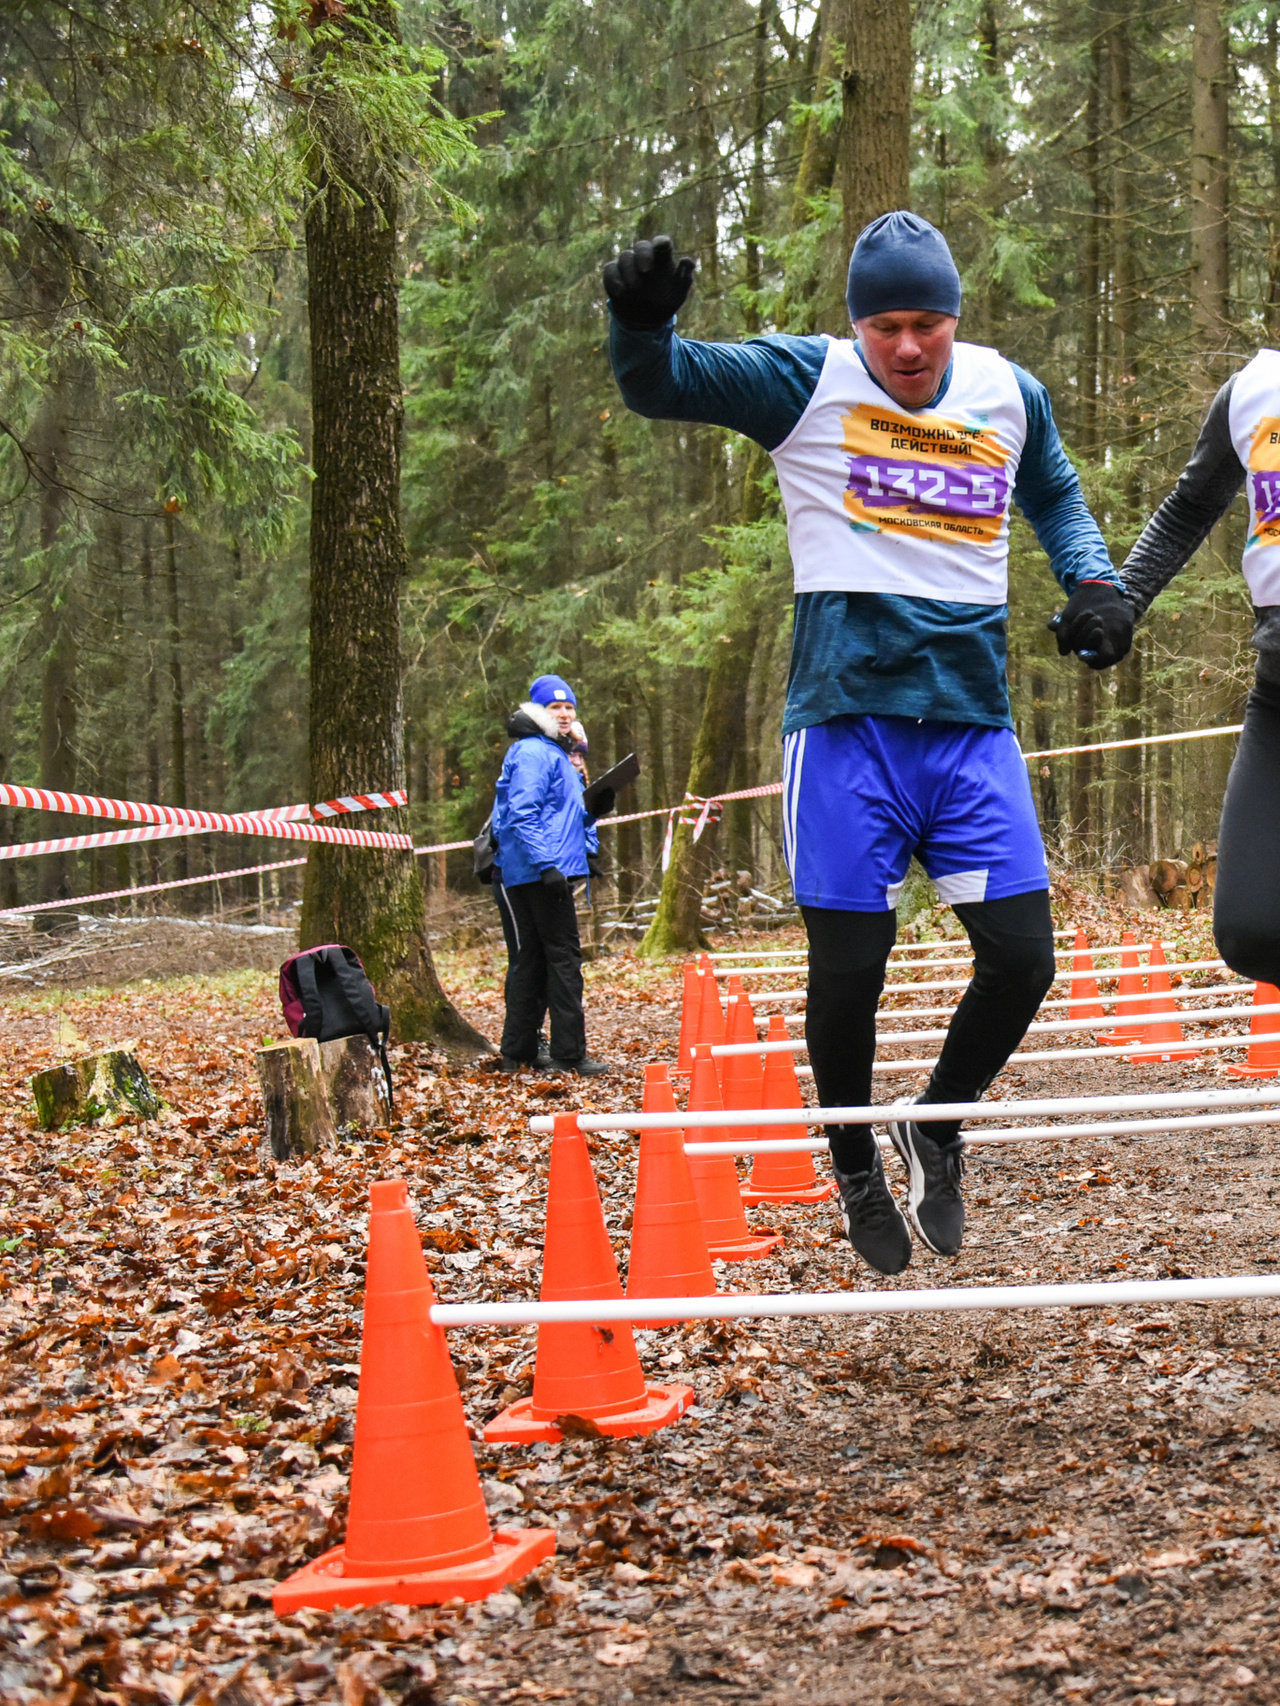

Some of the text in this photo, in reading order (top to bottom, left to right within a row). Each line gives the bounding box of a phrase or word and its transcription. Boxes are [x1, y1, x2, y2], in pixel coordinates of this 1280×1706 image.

[871, 418, 955, 441] ВОЗМОЖНО
[891, 437, 972, 456] ДЕЙСТВУЙ!
[866, 465, 997, 509] 132-5
[878, 517, 984, 535] МОСКОВСКАЯ ОБЛАСТЬ
